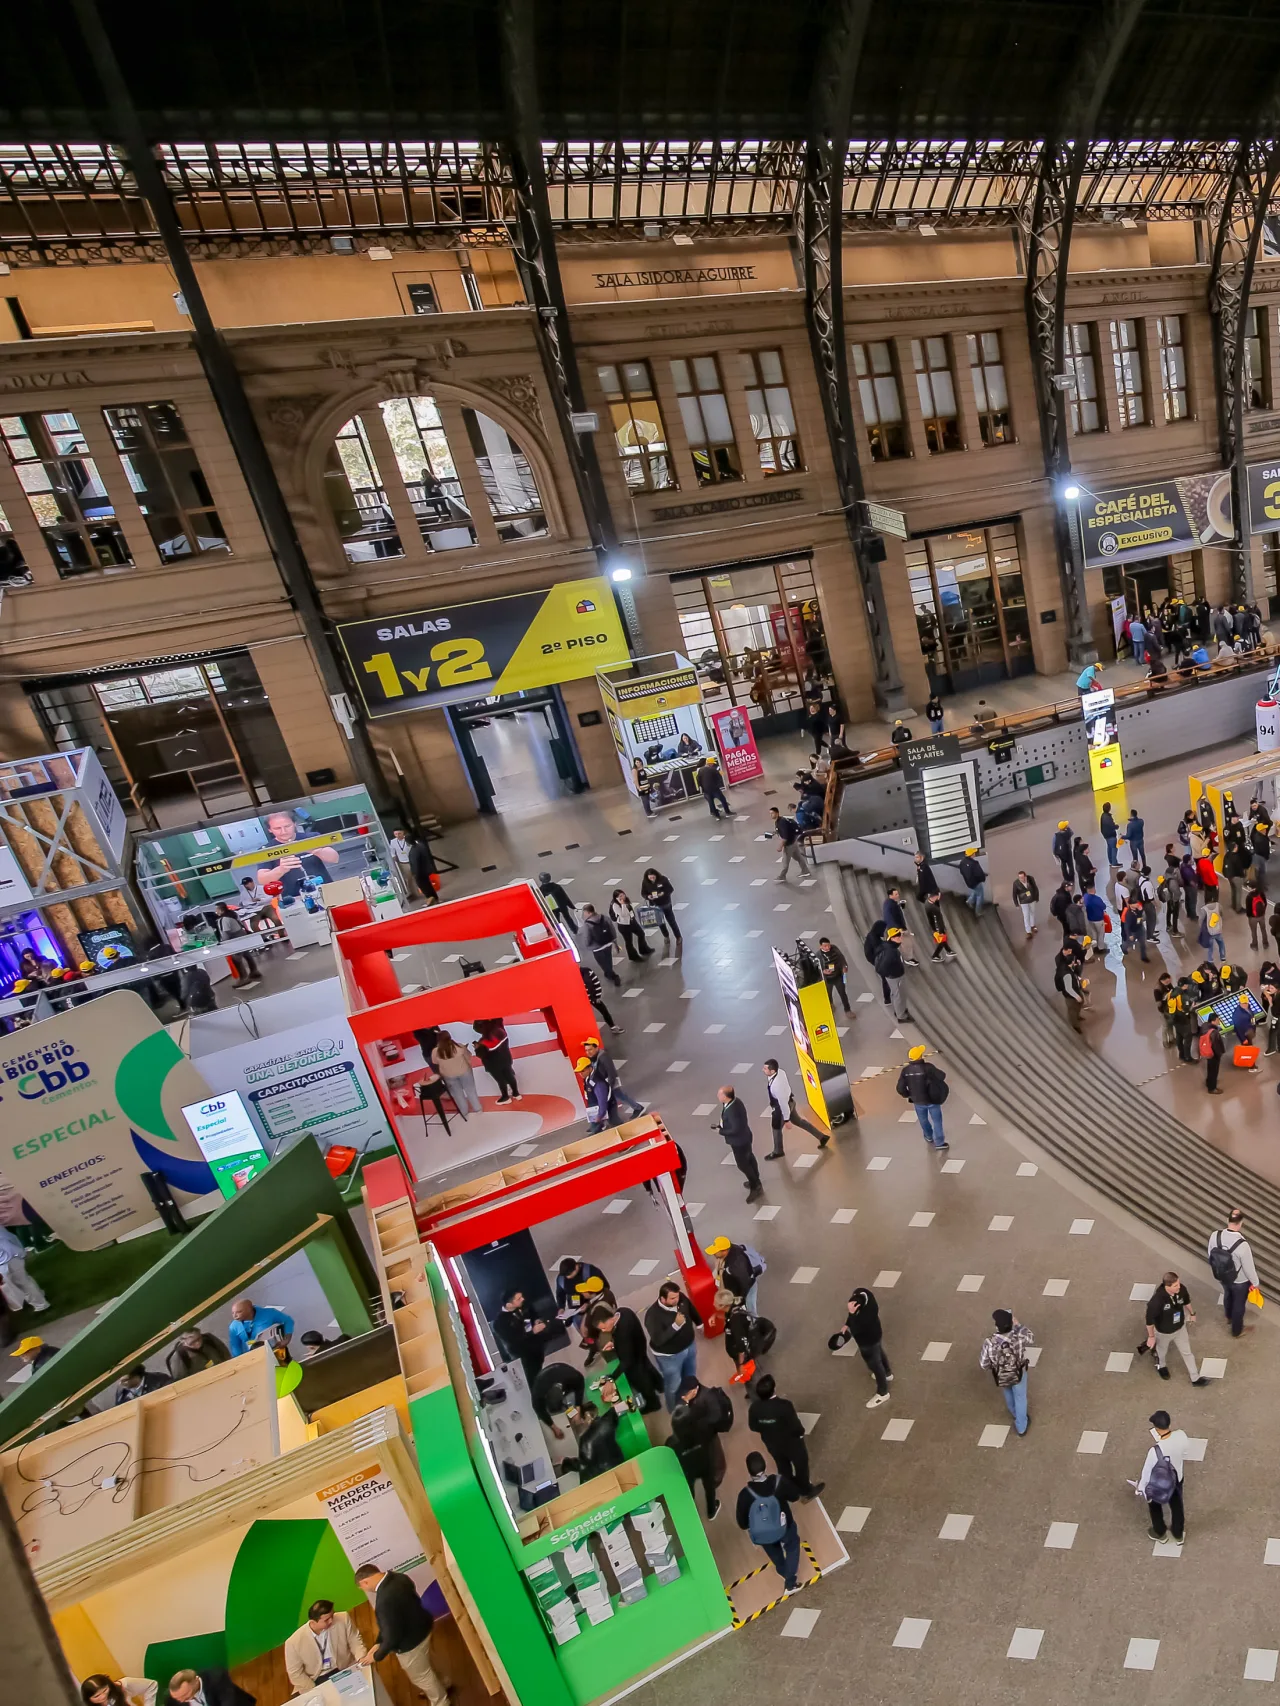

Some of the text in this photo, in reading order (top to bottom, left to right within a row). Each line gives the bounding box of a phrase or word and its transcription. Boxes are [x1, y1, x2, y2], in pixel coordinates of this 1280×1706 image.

[597, 266, 755, 287] SALA ISIDORA AGUIRRE
[1095, 493, 1169, 515] CAFÉ DEL
[1088, 505, 1177, 528] ESPECIALISTA
[1121, 530, 1169, 545] EXCLUSIVO
[377, 618, 451, 641] SALAS
[566, 633, 608, 651] PISO
[363, 652, 403, 698] 1
[430, 637, 493, 687] 2
[617, 673, 694, 695] INFORMACIONES
[1259, 725, 1275, 736] 94
[725, 749, 747, 761] PAGA
[727, 753, 757, 767] MENOS
[907, 744, 936, 755] SALA DE
[908, 749, 944, 762] LAS ARTES
[268, 848, 290, 857] PGIC
[213, 864, 223, 872] 16
[2, 1039, 66, 1068] CEMENTOS
[5, 1044, 75, 1080] BIO BIO
[246, 1047, 341, 1084] UNA BETONERA
[18, 1060, 90, 1100] Cbb
[257, 1064, 346, 1098] CAPACITACIONES
[41, 1079, 98, 1105] Cementos
[200, 1101, 225, 1115] Cbb
[12, 1108, 116, 1160] ESPECIAL
[197, 1117, 227, 1132] Especial
[39, 1155, 106, 1188] BENEFICIOS:
[321, 1474, 365, 1498] NUEVO
[327, 1480, 379, 1507] MADERA
[550, 1505, 616, 1545] Schneider
